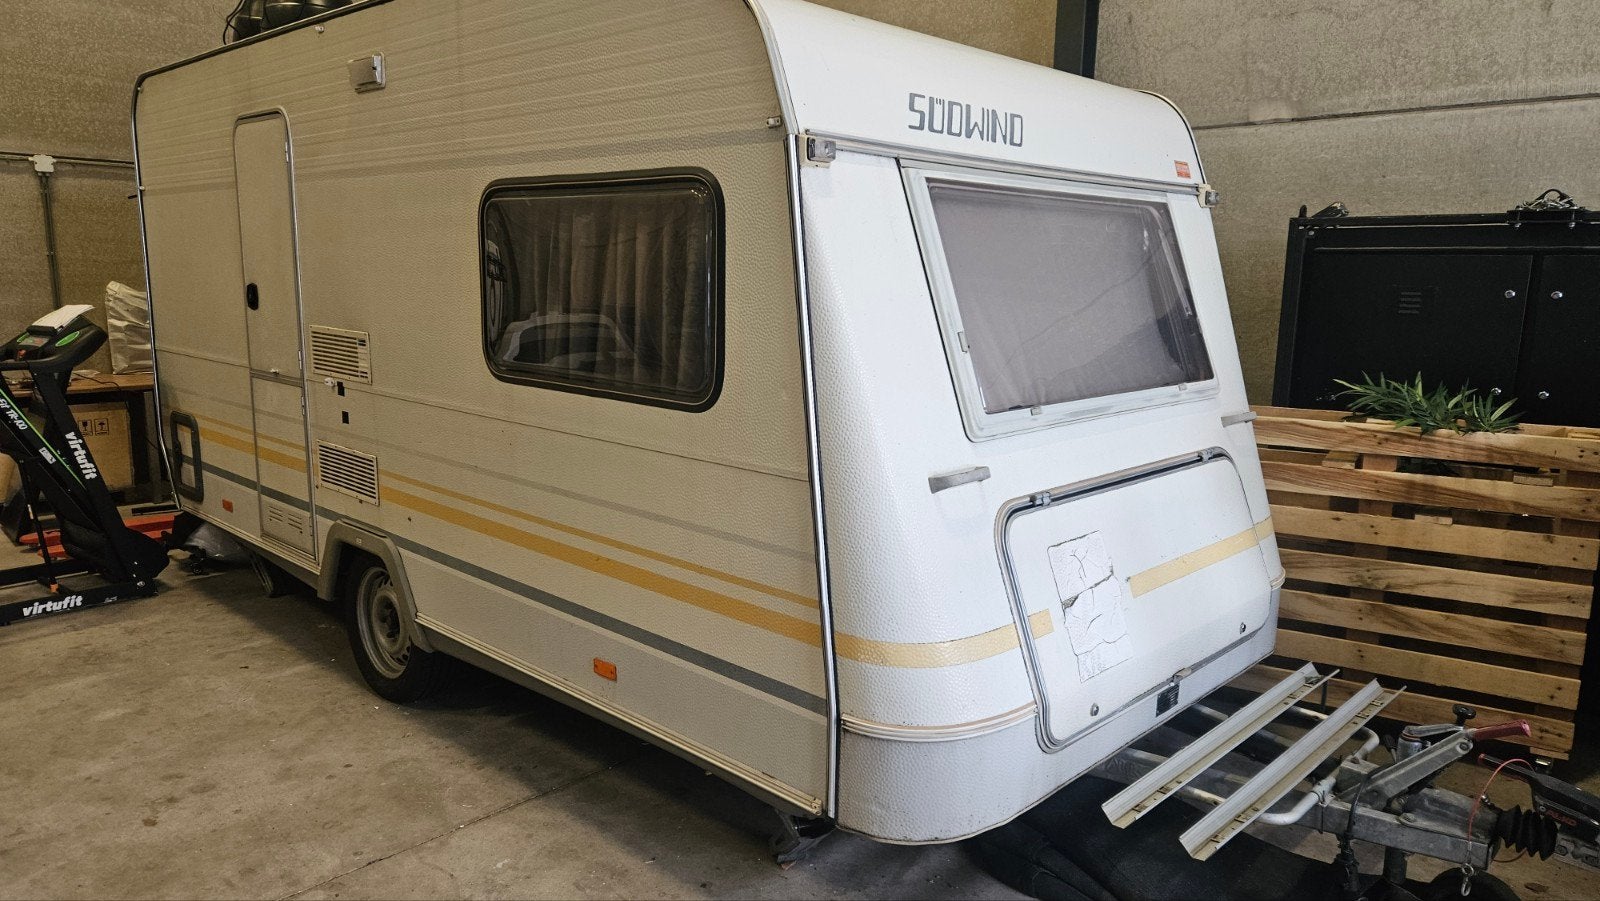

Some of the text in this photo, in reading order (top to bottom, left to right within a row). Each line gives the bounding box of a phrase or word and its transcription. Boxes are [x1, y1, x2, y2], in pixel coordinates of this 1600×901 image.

[908, 92, 1024, 147] SÜDWIND
[65, 431, 98, 480] virtufit
[22, 595, 83, 617] virtufit
